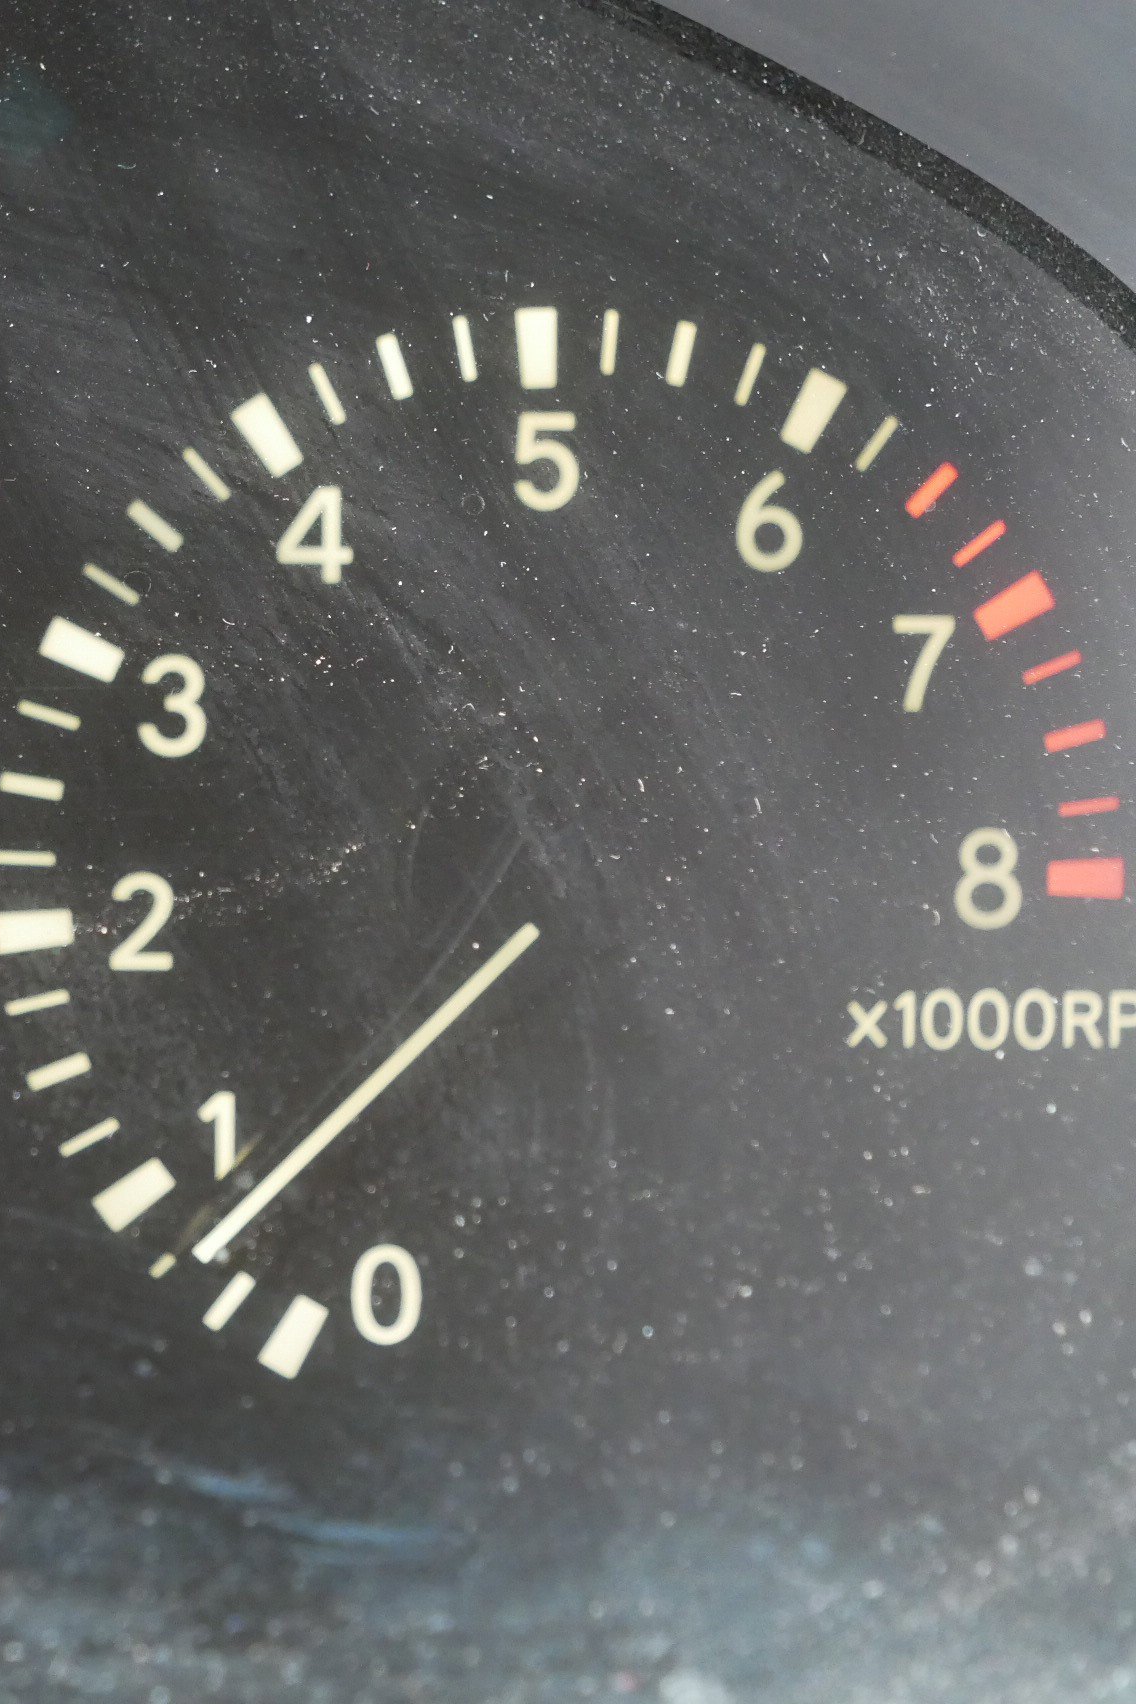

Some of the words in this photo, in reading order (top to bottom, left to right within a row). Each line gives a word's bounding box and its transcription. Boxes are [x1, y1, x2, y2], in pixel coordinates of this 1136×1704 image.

[515, 412, 579, 511] 5
[277, 485, 353, 584] 4
[736, 471, 802, 572] 6
[139, 654, 207, 757] 3
[893, 615, 955, 712] 7
[109, 872, 176, 971] 2
[954, 828, 1022, 930] 8
[198, 1091, 236, 1178] 1
[351, 1244, 422, 1345] 0
